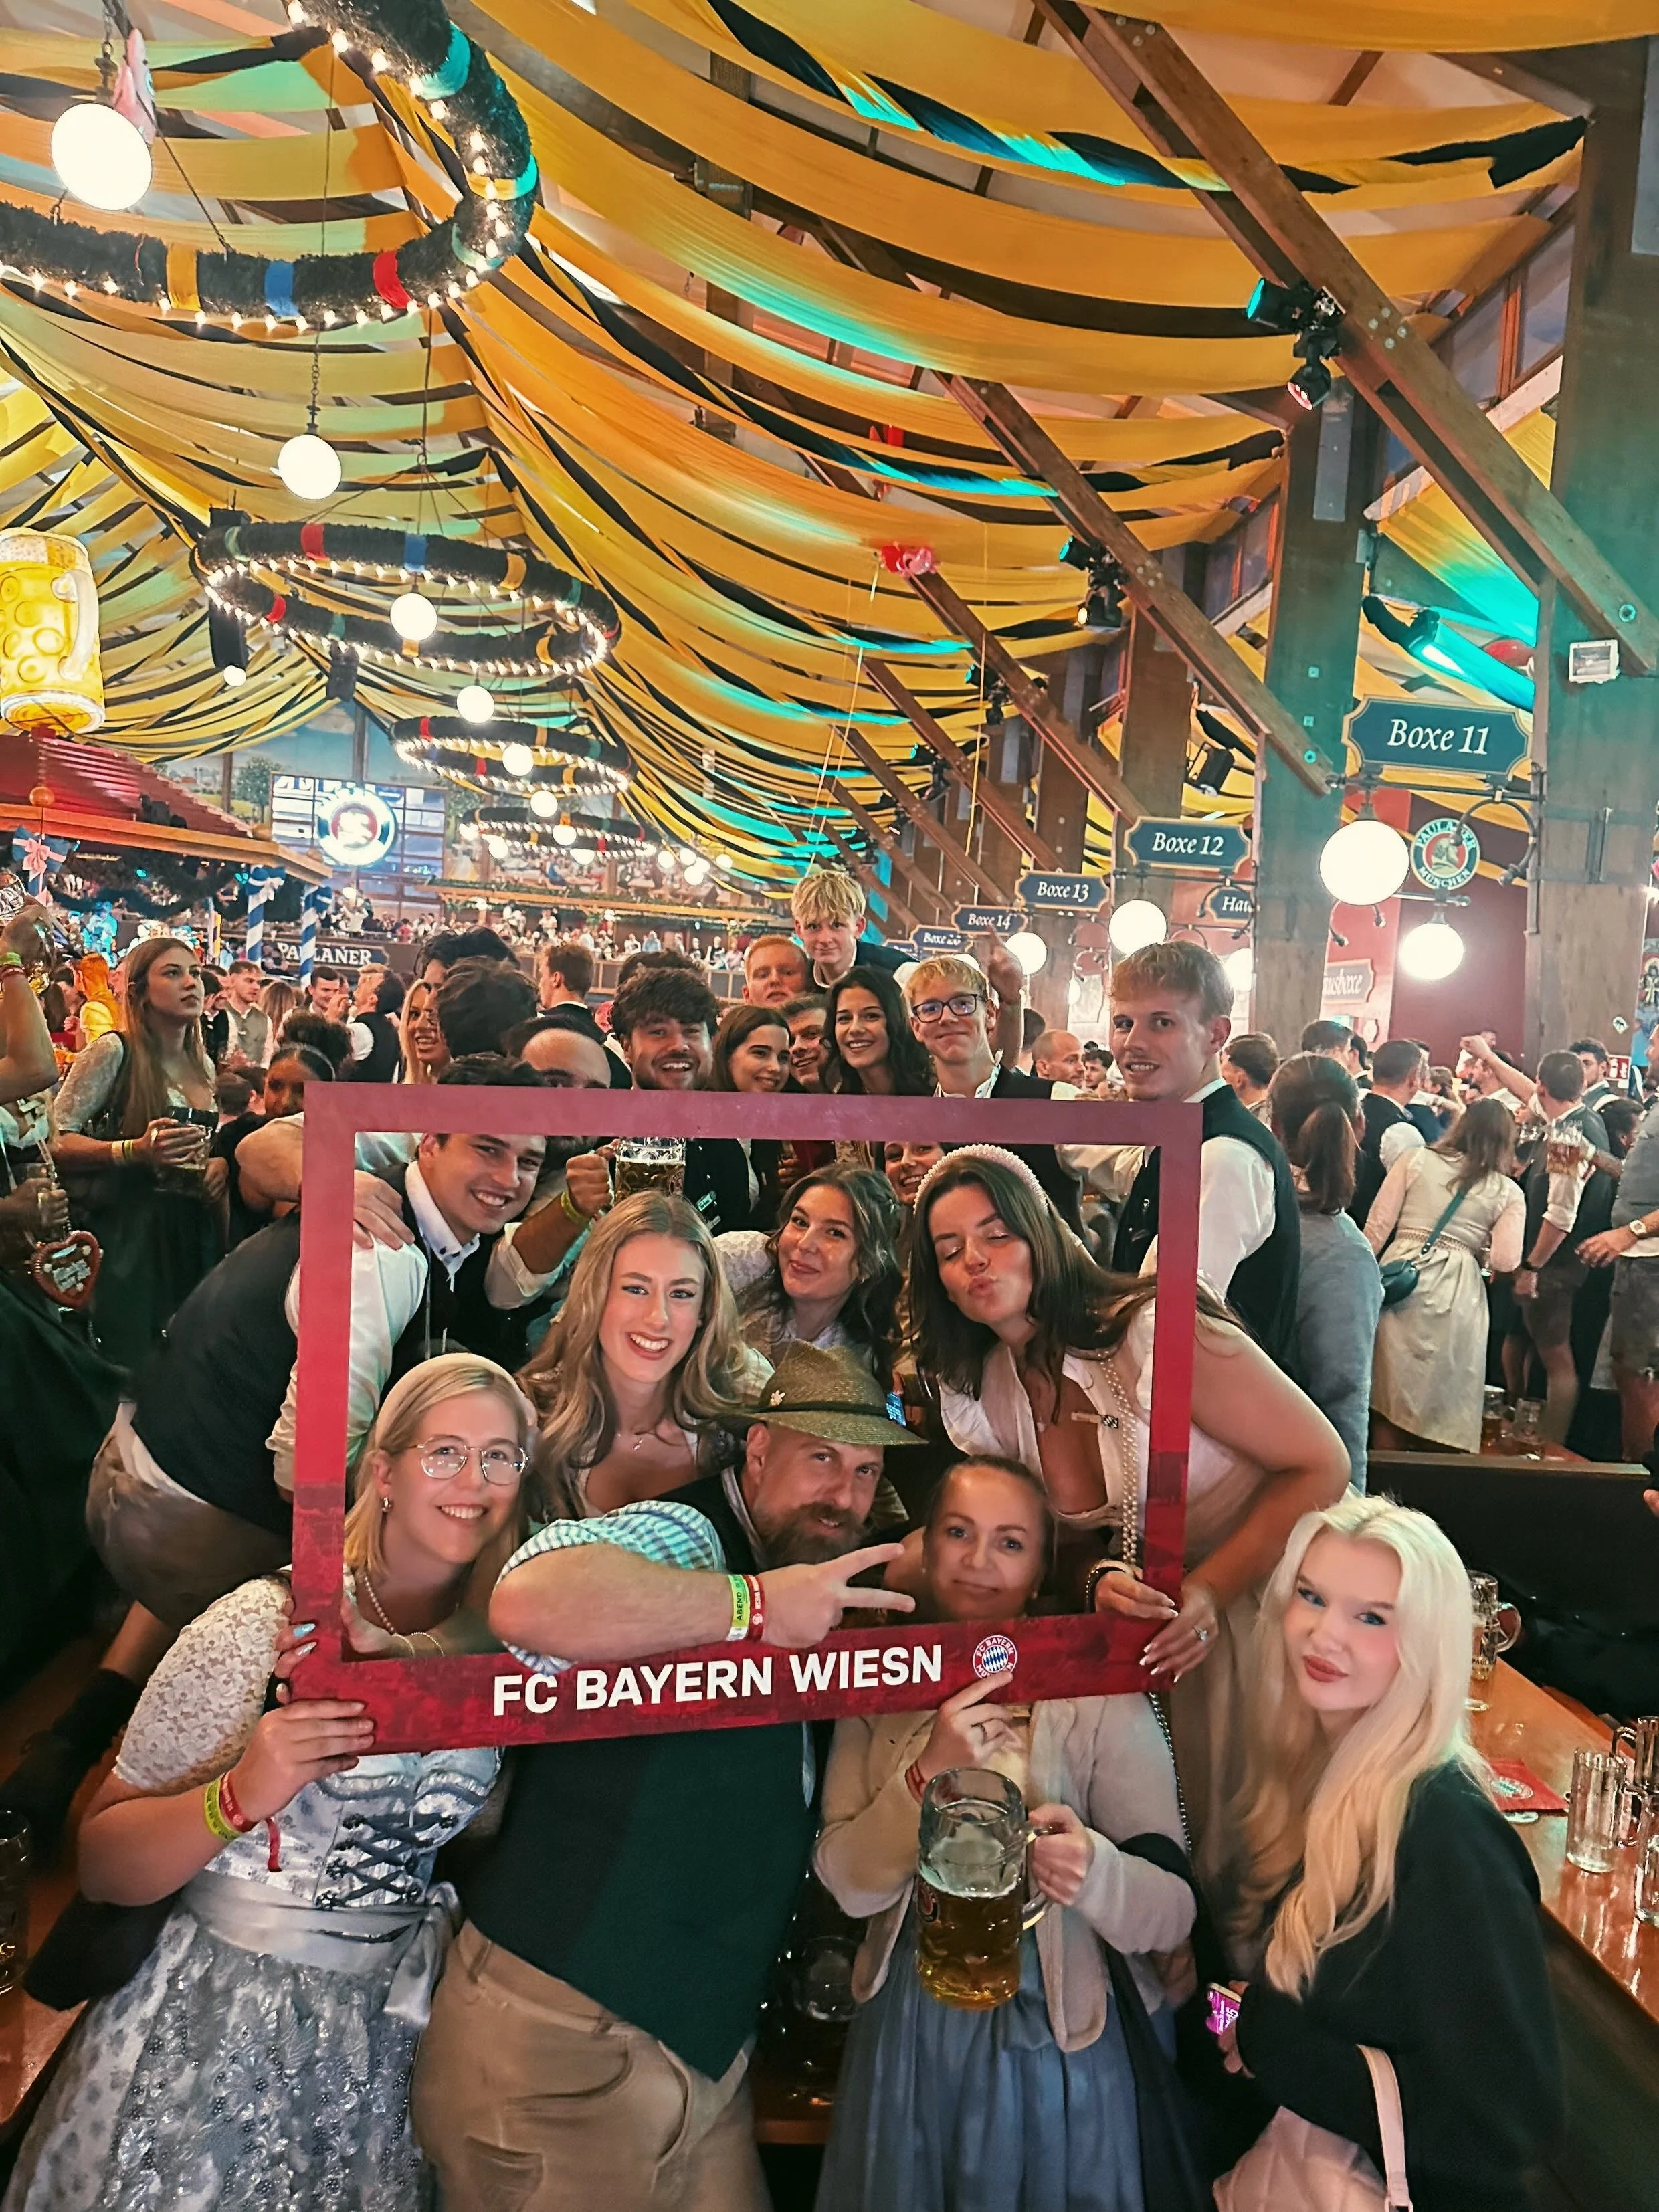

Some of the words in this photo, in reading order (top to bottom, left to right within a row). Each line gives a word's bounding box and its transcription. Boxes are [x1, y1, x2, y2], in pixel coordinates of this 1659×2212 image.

[1387, 718, 1454, 751] Boxe
[1458, 726, 1489, 755] 11
[1152, 832, 1197, 854] Boxe
[1199, 835, 1224, 856] 12
[1037, 881, 1070, 898] Boxe
[1072, 884, 1089, 903] 13
[967, 913, 995, 926] Boxe
[996, 914, 1011, 930] 14
[277, 942, 372, 965] PALANER
[976, 1645, 986, 1657] FC
[985, 1637, 1015, 1655] BAYERN
[494, 1673, 558, 1716] FC
[576, 1656, 772, 1710] BAYERN
[789, 1644, 942, 1692] WIESN
